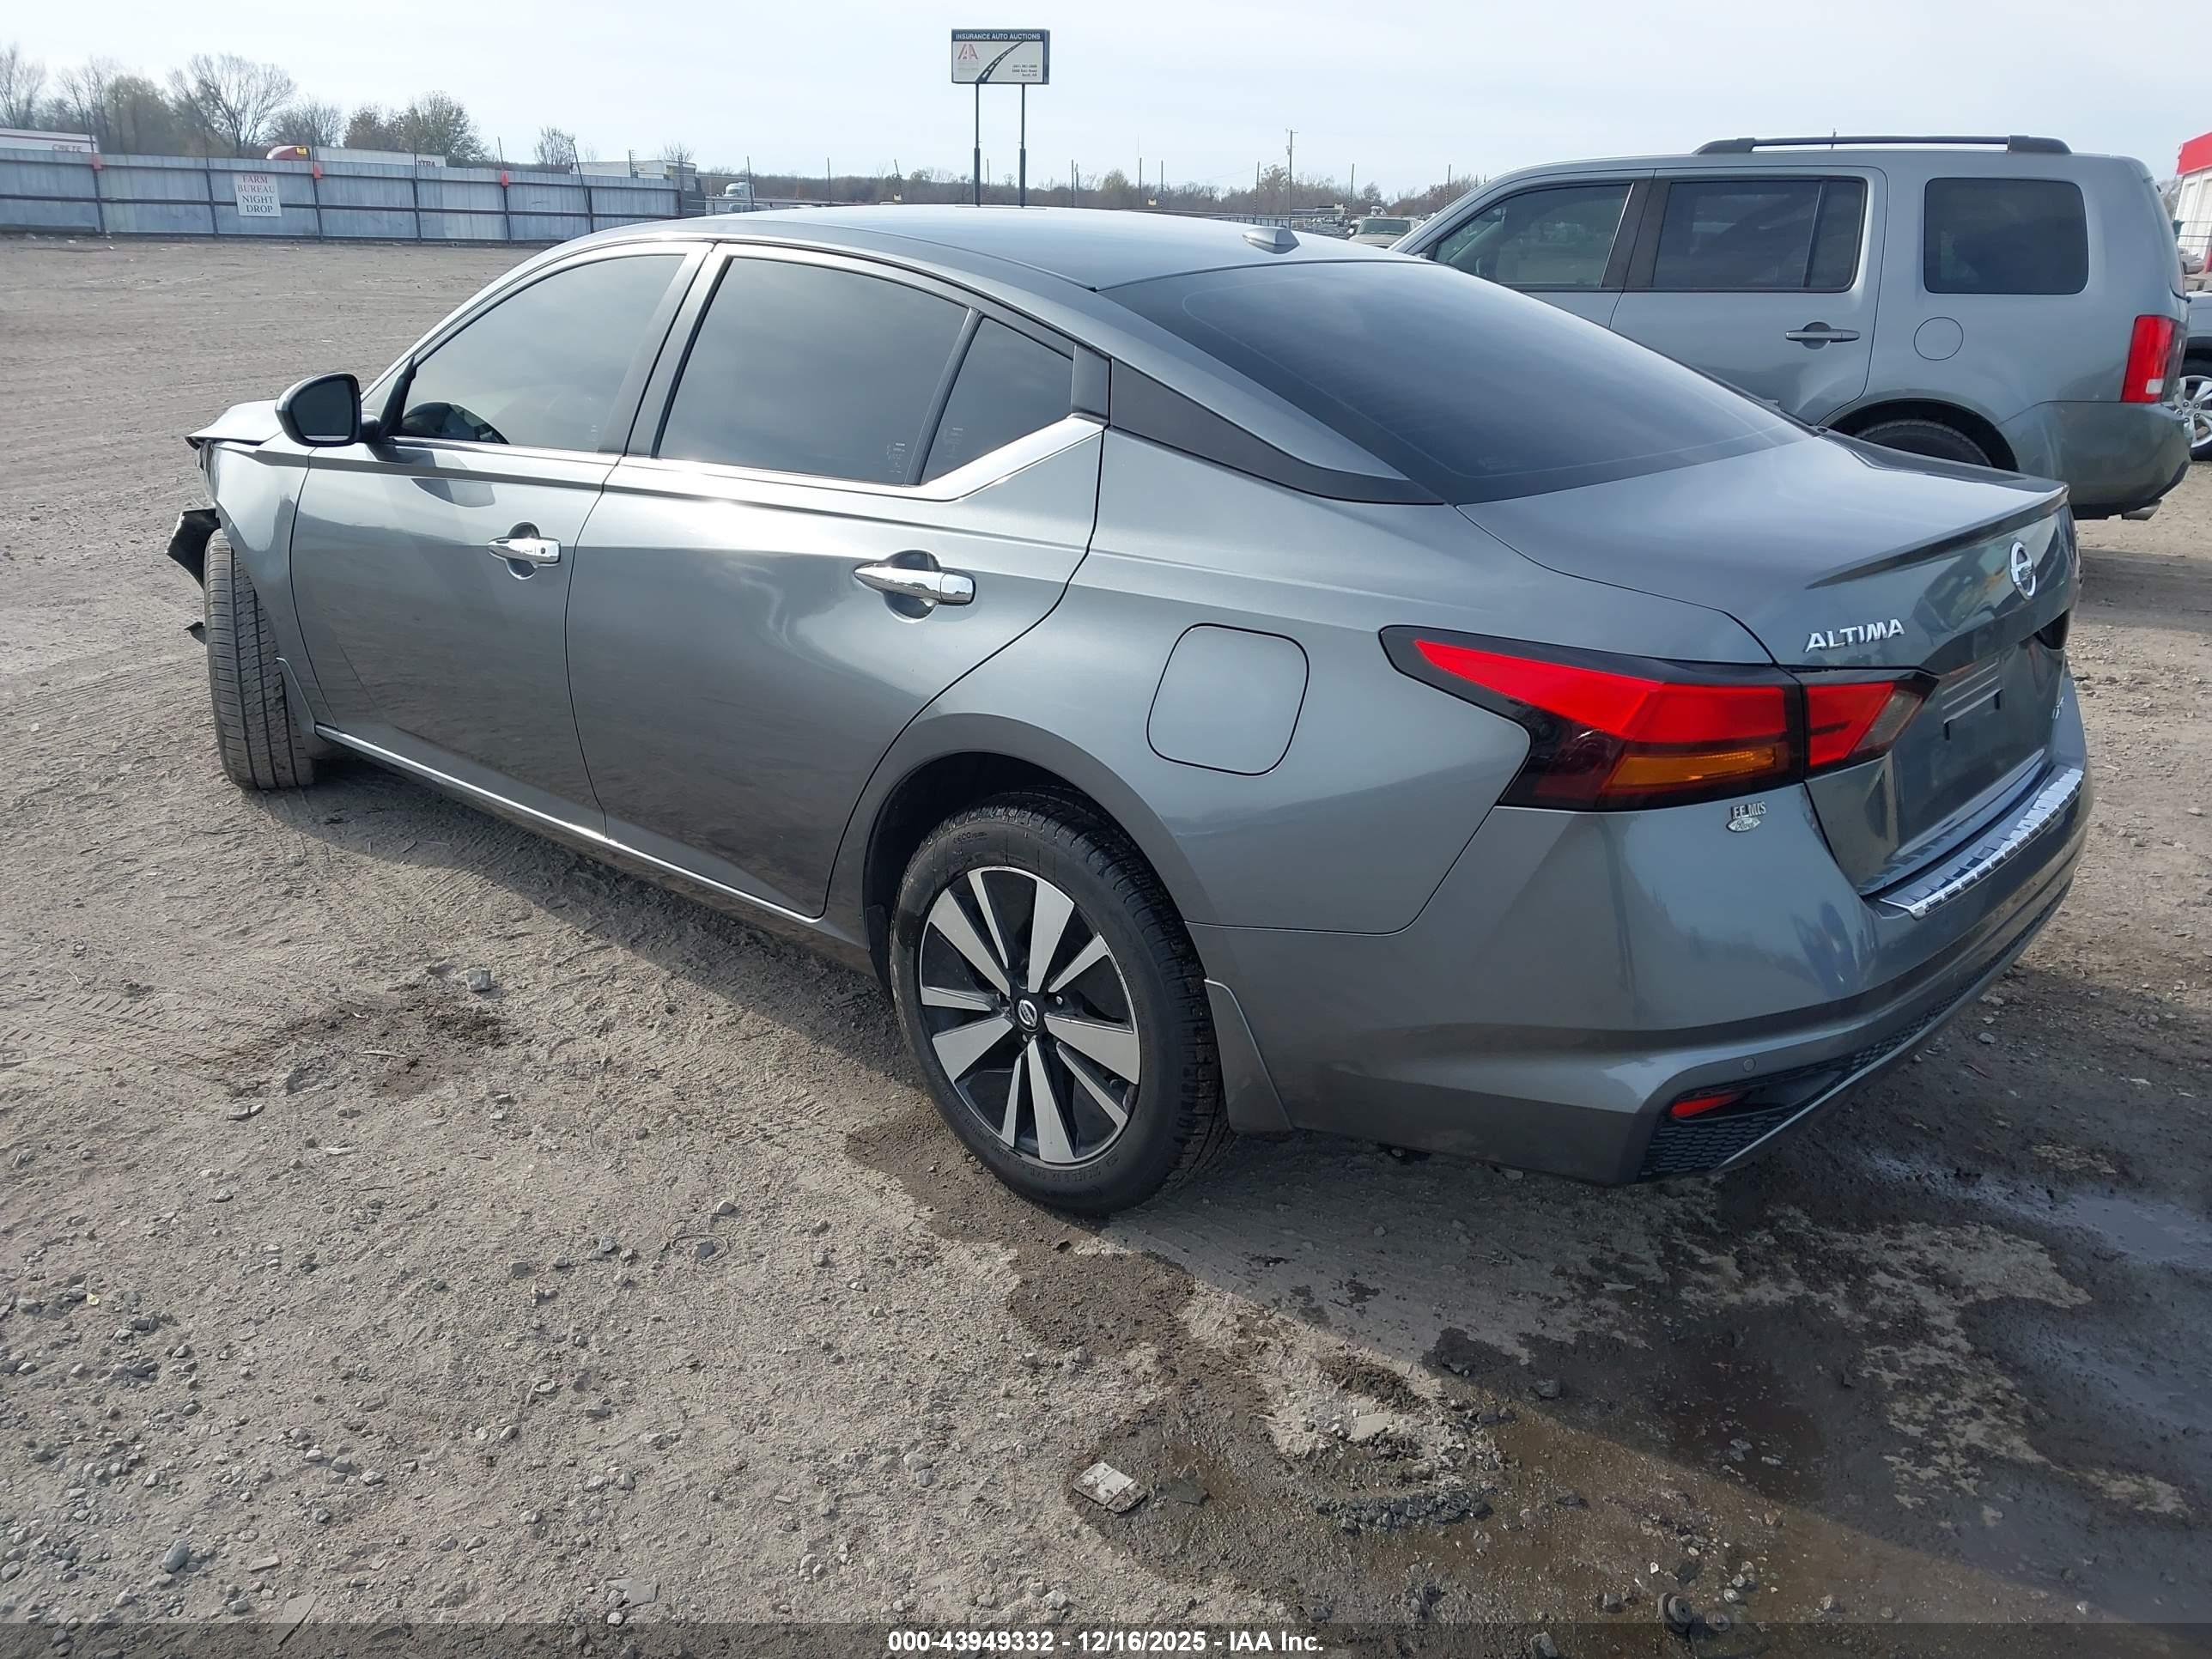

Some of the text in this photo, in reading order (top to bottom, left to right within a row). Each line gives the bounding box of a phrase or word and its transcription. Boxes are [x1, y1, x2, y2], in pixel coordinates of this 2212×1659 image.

[242, 174, 268, 184] FARM
[237, 185, 276, 193] BUREAU
[242, 195, 274, 204] NIGHT
[246, 204, 273, 213] DROP
[1804, 617, 1905, 653] ALTIMA
